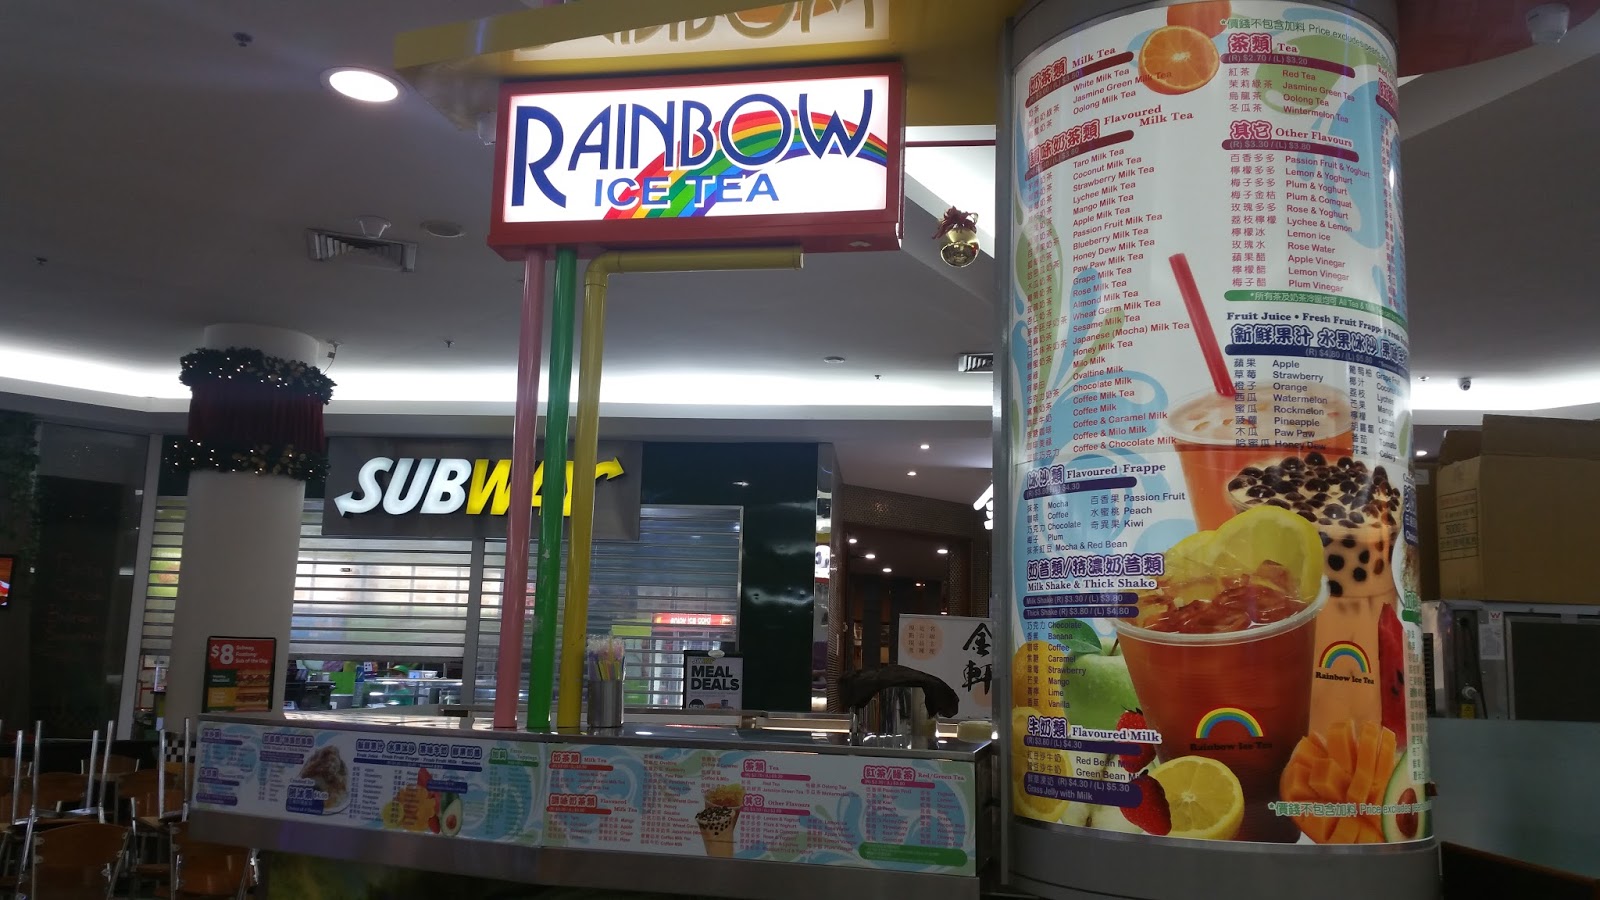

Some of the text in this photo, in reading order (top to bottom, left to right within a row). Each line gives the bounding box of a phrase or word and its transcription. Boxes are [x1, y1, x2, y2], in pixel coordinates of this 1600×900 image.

[1309, 24, 1330, 36] Price
[1228, 33, 1298, 54] 茶類 Tea
[1072, 55, 1093, 68] Milk
[1097, 48, 1115, 58] Tea
[1243, 54, 1266, 62] $2.70
[1273, 56, 1284, 64] (L)
[1286, 57, 1308, 65] $3.20
[1229, 68, 1315, 80] 紅茶 Red Tea
[1283, 82, 1317, 92] Jasmine
[1319, 86, 1341, 97] Green
[1343, 93, 1355, 101] Tea
[1283, 93, 1313, 105] Oolong
[1315, 97, 1329, 106] Tea
[1104, 105, 1162, 125] Flavoured
[1140, 114, 1167, 126] Milk
[1171, 112, 1193, 120] Tea
[1283, 105, 1334, 119] Wintermelon
[1336, 113, 1348, 123] Tea
[1230, 120, 1352, 147] 其它 Other Flavours
[511, 89, 873, 209] RAINBOW
[1073, 164, 1104, 181] Coconut
[1106, 160, 1123, 170] Milk
[1231, 154, 1275, 163] 百香多多
[1286, 156, 1318, 166] Passion
[1320, 160, 1337, 169] Fruit
[1346, 165, 1371, 179] Yoghurt
[1073, 166, 1154, 192] Strawberry Milk Tea
[594, 173, 778, 206] ICE TEA
[1073, 213, 1163, 238] Passion Fruit Milk Tea
[1287, 230, 1316, 239] Lemon
[1319, 232, 1330, 241] ice
[1288, 255, 1313, 265] Apple
[1315, 257, 1345, 268] Vinegar
[1227, 312, 1258, 321] Fruit
[1261, 313, 1291, 321] Juice
[1302, 313, 1330, 324] Fresh
[1333, 317, 1356, 326] Fruit
[1073, 322, 1190, 345] Japanese (Mocha) Milk Tea
[1231, 324, 1314, 346] 新鮮果汁
[1272, 359, 1300, 369] Apple
[1073, 366, 1123, 380] Ovaltine Milk
[1273, 371, 1323, 382] Strawberry
[1273, 382, 1307, 393] Orange
[1235, 393, 1327, 404] 西瓜 Watermelon
[1073, 412, 1168, 428] Coffee & Caramel Milk
[1274, 417, 1319, 427] Pineapple
[1236, 428, 1315, 438] 木瓜 Paw Paw
[1067, 466, 1117, 479] Flavoured
[1123, 464, 1166, 476] Frappe
[1090, 493, 1185, 505] 百香果 Passion Fruit
[1091, 508, 1120, 517] 水蜜桃
[1056, 543, 1078, 551] Mocha
[1087, 541, 1103, 549] Red
[1105, 540, 1127, 548] Bean
[1028, 578, 1155, 591] Milk Shake & Thick Shake
[1094, 607, 1105, 615] (L)
[1107, 607, 1129, 615] $4.80
[1048, 621, 1082, 629] Chocolate
[211, 644, 234, 664] $8
[692, 666, 733, 677] MEAL
[1048, 666, 1086, 676] Strawberry
[691, 679, 739, 690] DEALS
[1316, 672, 1350, 682] Rainbow
[1364, 677, 1374, 685] Tea
[1028, 716, 1160, 742] 牛奶類 Flavoured Milk
[1076, 768, 1126, 780] Green Bean
[1060, 789, 1075, 799] with
[1077, 790, 1092, 800] Milk
[1360, 804, 1381, 815] Price
